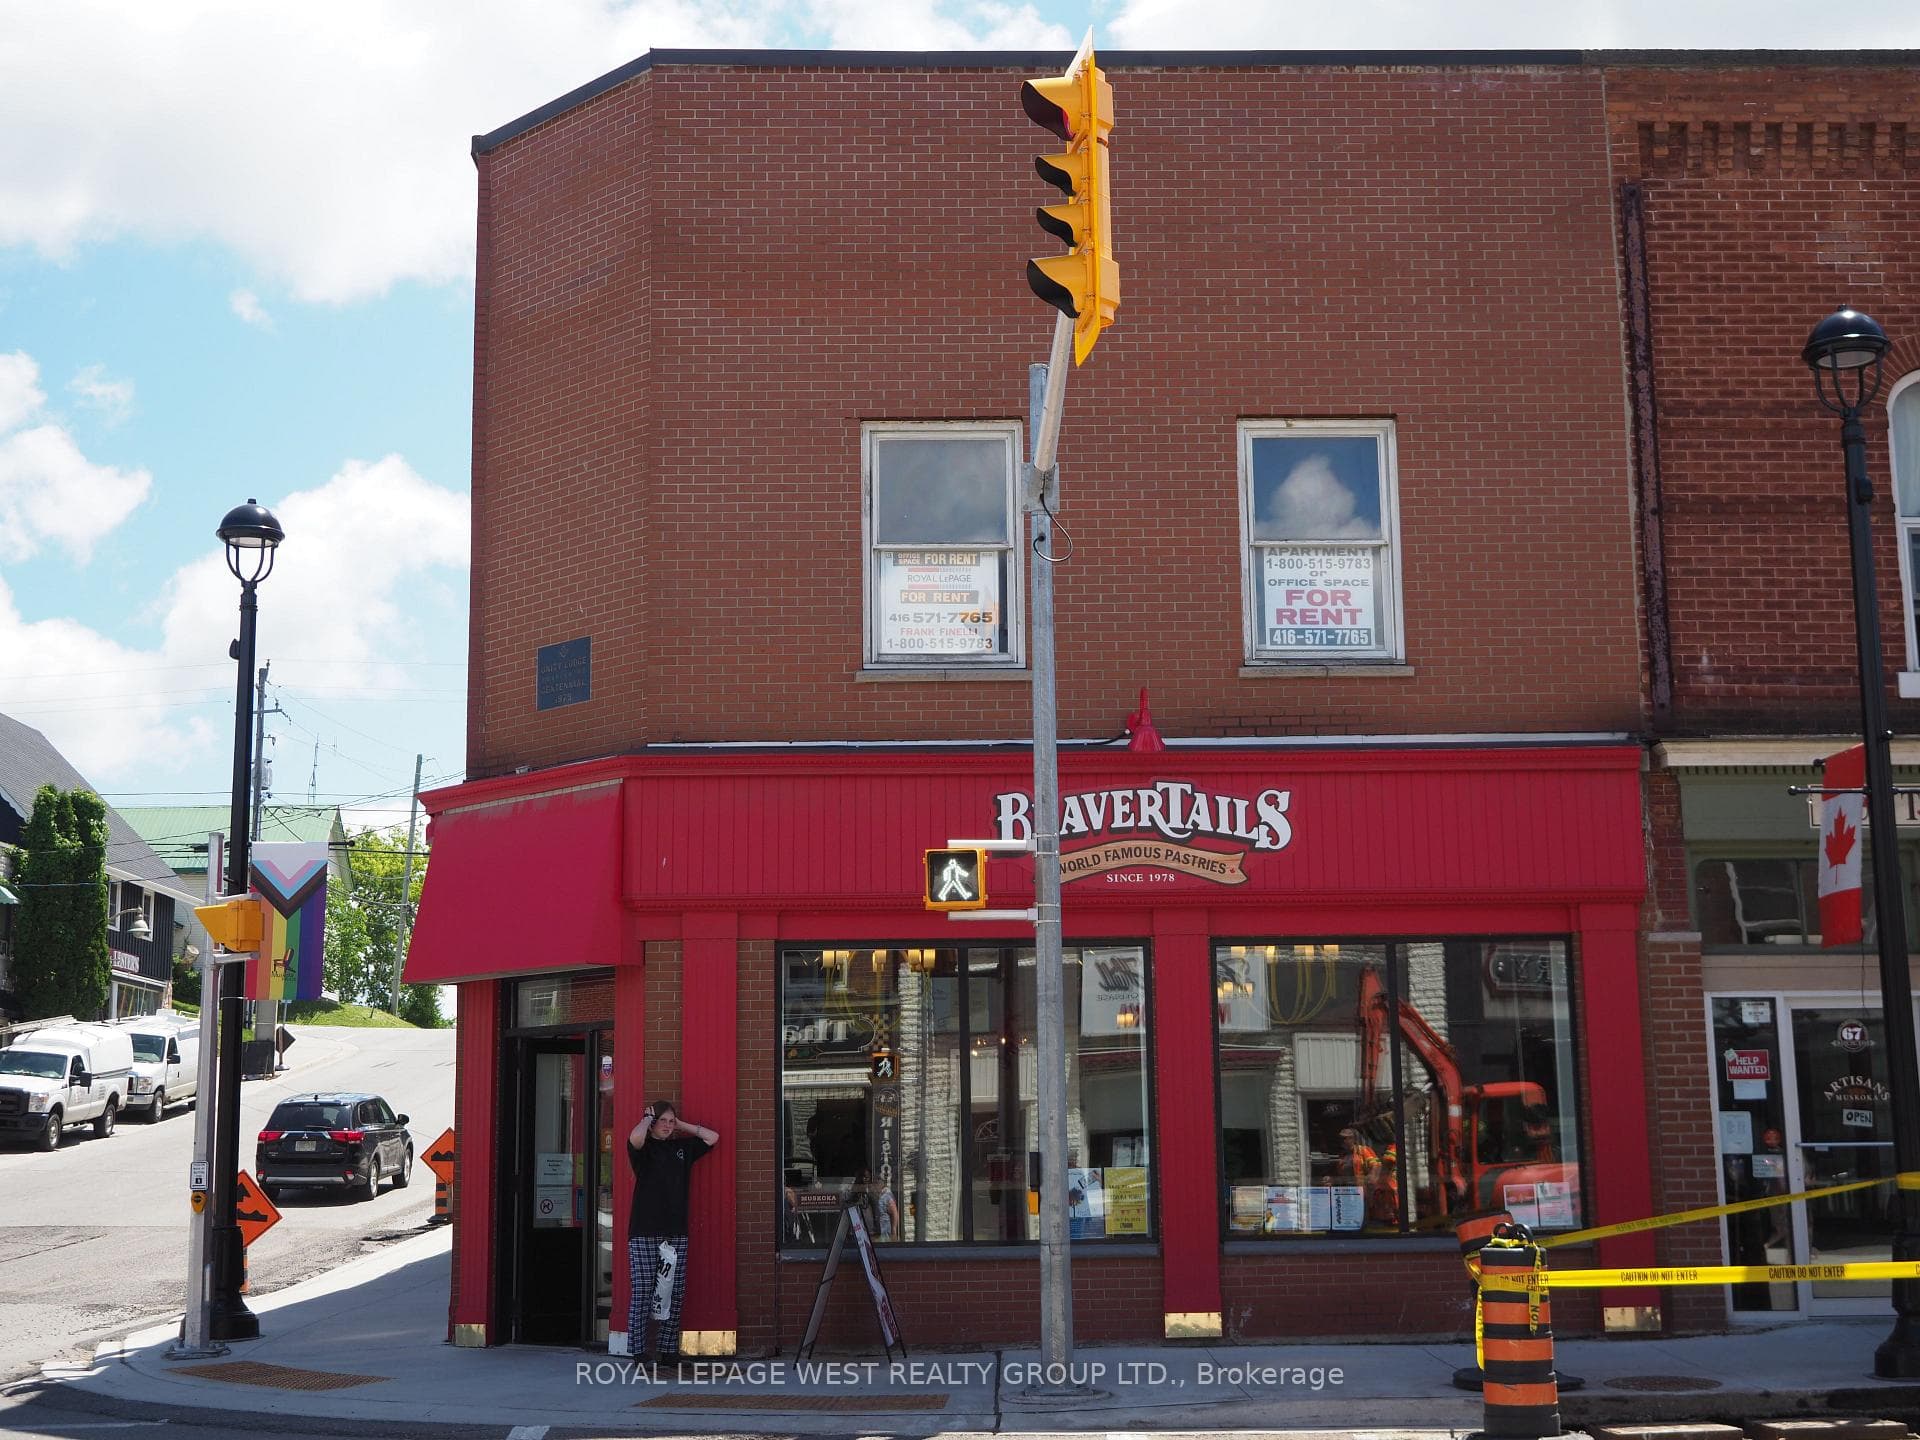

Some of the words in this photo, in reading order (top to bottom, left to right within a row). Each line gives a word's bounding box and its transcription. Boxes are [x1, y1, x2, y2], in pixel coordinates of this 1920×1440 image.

[1268, 548, 1368, 556] APARTMENT
[925, 553, 946, 565] FOR
[949, 553, 977, 565] RENT
[1266, 558, 1371, 569] 1-800-515-9783
[907, 574, 938, 583] ROYAL
[1268, 579, 1317, 587] OFFICE
[1323, 579, 1369, 587] SPACE
[901, 592, 927, 602] FOR
[933, 592, 970, 603] RENT
[1285, 589, 1352, 607] FOR
[889, 613, 910, 623] 416
[913, 611, 993, 623] 571-7765
[1276, 608, 1363, 625] RENT
[901, 627, 935, 636] FRANK
[1272, 629, 1369, 645] 416-571-7765
[886, 638, 993, 649] 1-800-515-9783
[996, 780, 1293, 851] BAVERTAILS
[1104, 846, 1162, 863] FAMOUS
[1164, 849, 1227, 875] PASTRIES
[1106, 873, 1144, 883] SINCE
[1148, 872, 1175, 882] 1978
[1841, 1027, 1863, 1041] 67
[1736, 1056, 1760, 1066] HELP
[1729, 1065, 1768, 1075] WANTED
[1824, 1075, 1890, 1101] ARTISANS
[1846, 1111, 1872, 1123] OPEN
[1620, 1271, 1648, 1282] CAUTION
[1649, 1271, 1660, 1281] DO
[1661, 1271, 1675, 1281] NOT
[1676, 1271, 1698, 1281] ENTER
[1768, 1267, 1796, 1279] CAUTION
[1797, 1267, 1807, 1278] DO
[1808, 1267, 1821, 1278] NOT
[1823, 1266, 1845, 1278] ENTER
